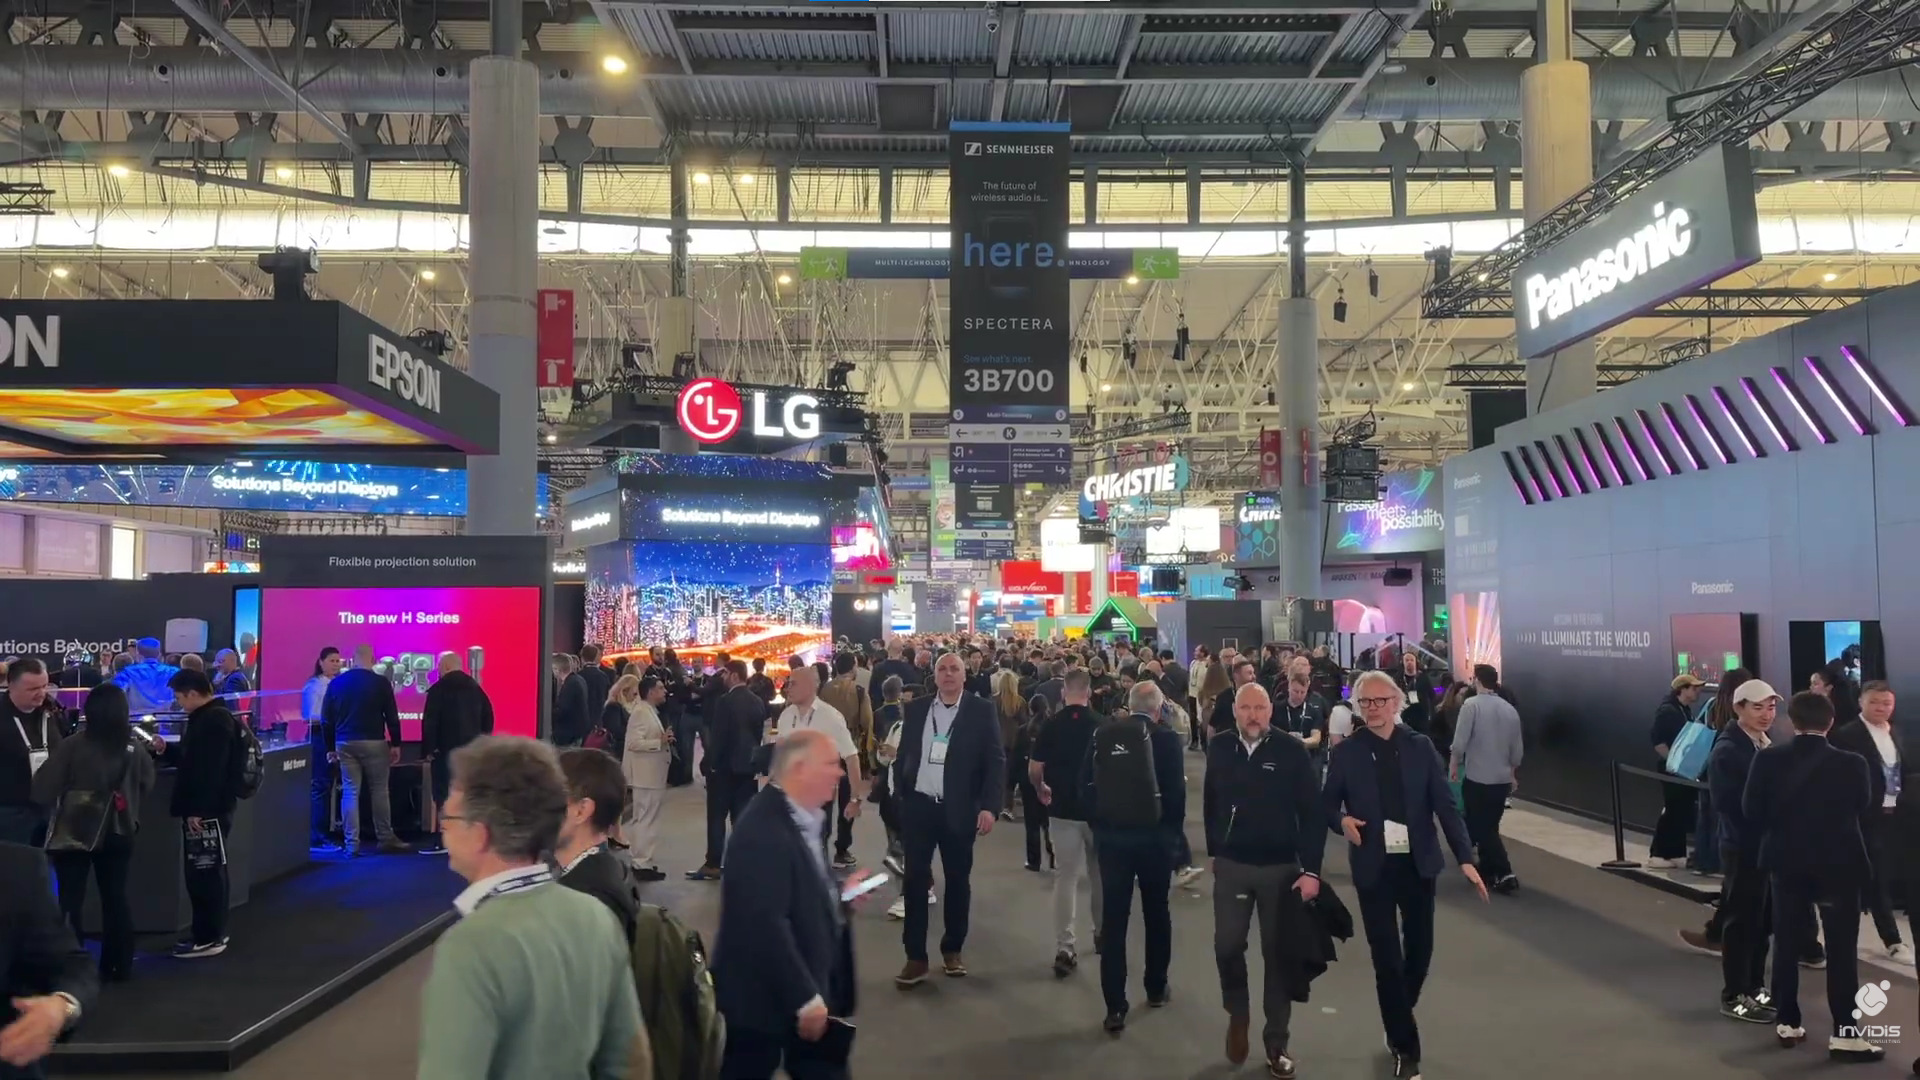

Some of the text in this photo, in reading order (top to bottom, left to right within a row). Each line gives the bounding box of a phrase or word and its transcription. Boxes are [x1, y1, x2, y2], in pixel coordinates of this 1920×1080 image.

[986, 144, 1054, 154] SENNHEISER
[983, 181, 1037, 190] The future of
[970, 192, 1006, 201] wireless
[1008, 192, 1031, 202] audio
[964, 233, 1064, 267] here.
[1526, 201, 1691, 329] Panasonic
[964, 318, 1053, 330] SPECTERA
[368, 333, 440, 413] EPSON
[964, 369, 1054, 392] 3B700
[754, 392, 820, 439] LG
[212, 475, 398, 498] Solutions Beyond Displays
[1084, 463, 1176, 502] CHRISTIE
[662, 508, 820, 527] Solutions Beyond Displays
[1367, 504, 1406, 520] meets
[1380, 508, 1444, 535] possibility
[329, 556, 476, 568] Flexible projection solution
[1692, 580, 1734, 594] Panasonic
[338, 611, 460, 624] The new H Series
[1541, 630, 1650, 647] ILLUMINATE THE WORLD
[1755, 993, 1771, 1004] N
[1733, 1004, 1748, 1016] N
